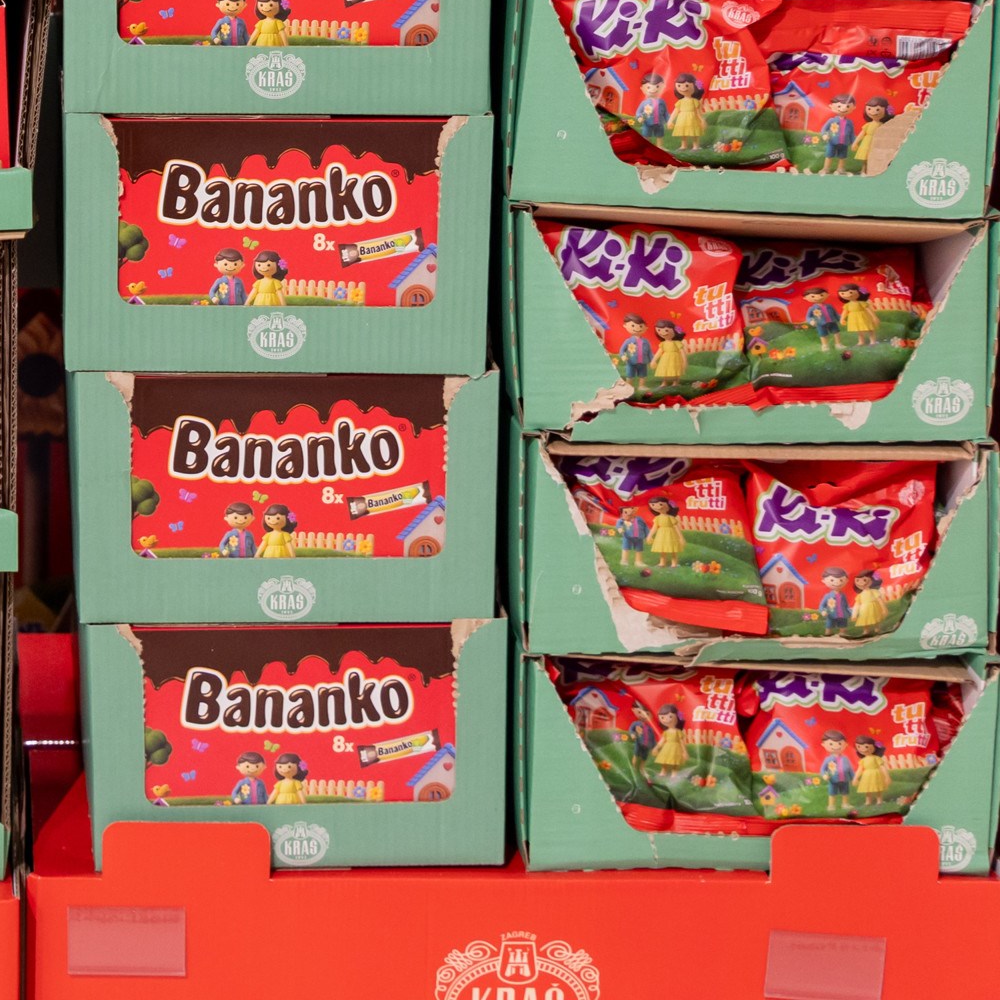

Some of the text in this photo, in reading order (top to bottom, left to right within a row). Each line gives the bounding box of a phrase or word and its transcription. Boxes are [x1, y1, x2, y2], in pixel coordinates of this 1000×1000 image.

[713, 36, 742, 61] tu
[719, 58, 748, 79] tti
[160, 161, 394, 227] Bananko
[313, 232, 335, 251] 8x
[359, 239, 395, 255] Bananko
[561, 228, 683, 291] Ki-Ki
[694, 282, 727, 306] tu
[704, 293, 733, 320] tti
[171, 418, 401, 482] Bananko
[321, 487, 344, 504] 8x
[695, 481, 723, 499] tti
[367, 492, 403, 509] Bananko
[686, 496, 727, 511] frutti
[757, 484, 892, 542] Ki-Ki
[891, 530, 923, 558] tu
[700, 675, 734, 694] tu
[183, 670, 410, 731] Bananko
[707, 693, 736, 711] tti
[891, 702, 925, 723] tu
[333, 735, 354, 753] 8x
[377, 740, 413, 757] Bananko
[500, 930, 537, 942] ZAGREB
